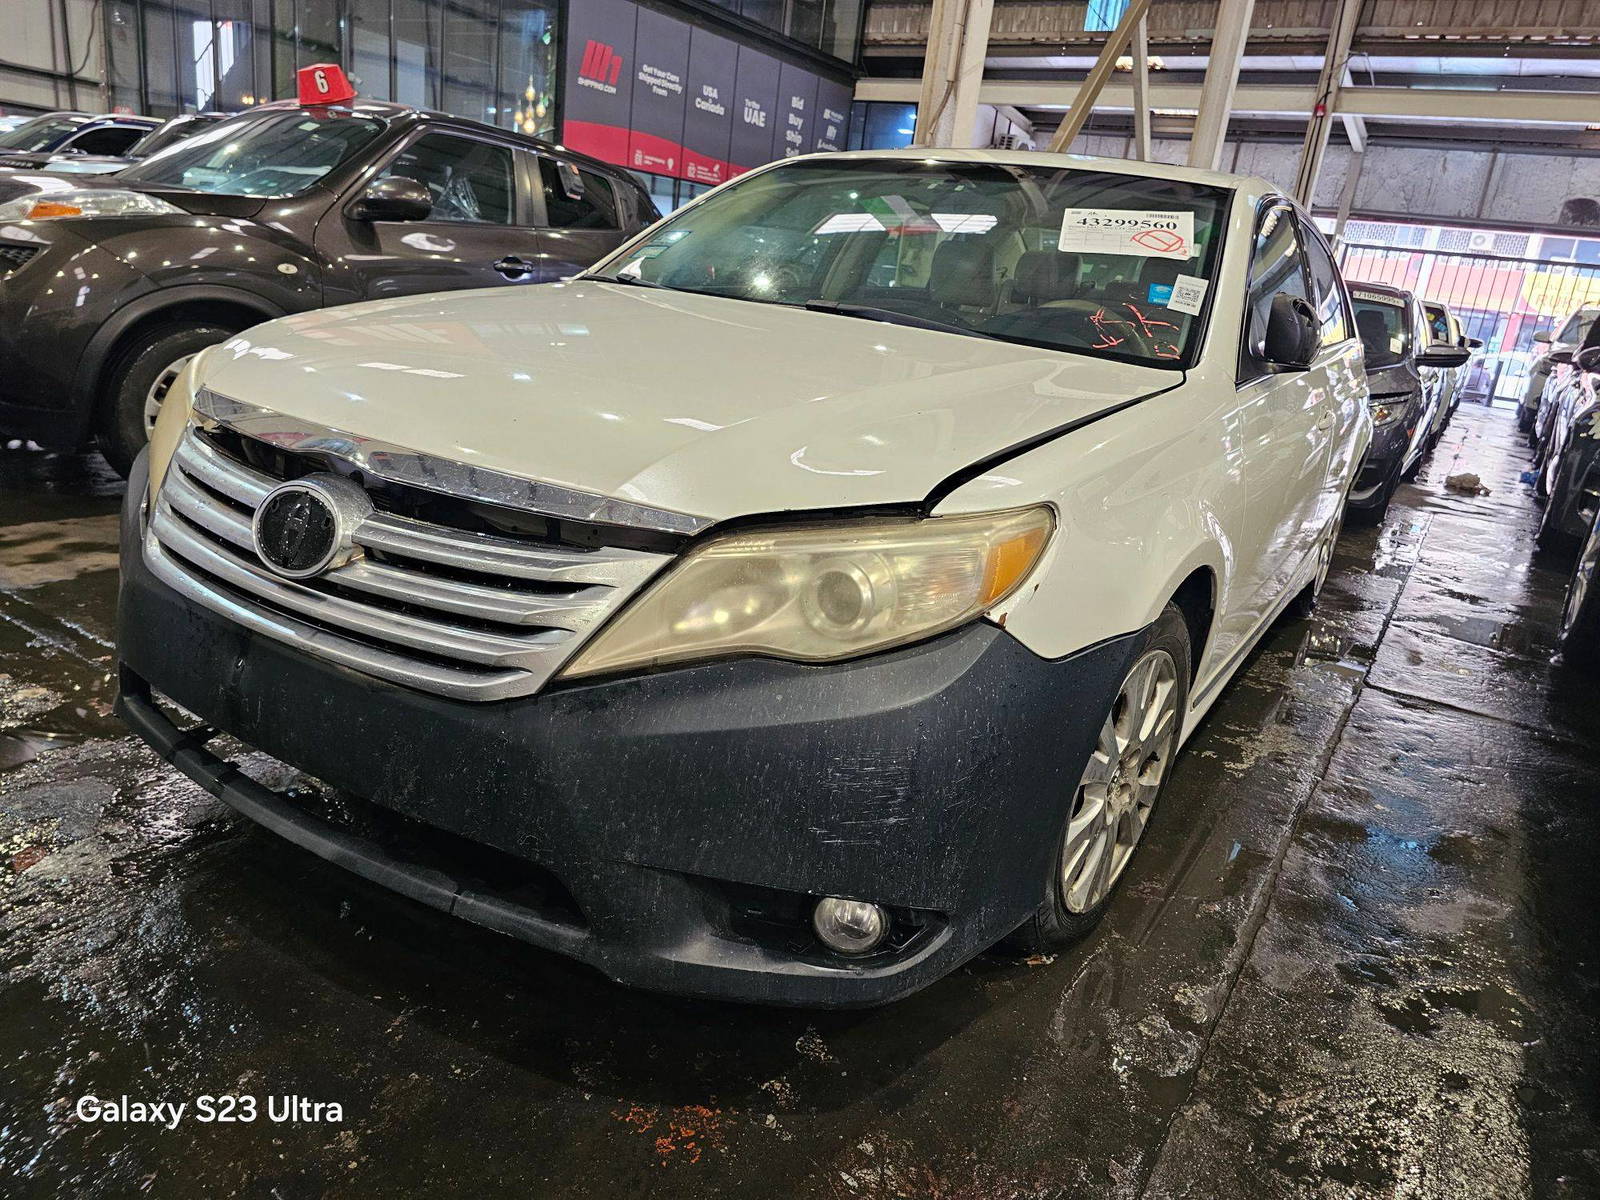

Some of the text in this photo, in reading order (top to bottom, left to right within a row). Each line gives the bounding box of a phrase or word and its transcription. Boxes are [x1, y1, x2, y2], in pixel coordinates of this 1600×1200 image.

[643, 64, 680, 82] Get Your Cars
[314, 70, 329, 94] 6
[638, 72, 682, 94] Shipped Directly
[652, 86, 668, 96] From
[702, 85, 718, 100] USA
[696, 98, 724, 116] Canada
[792, 96, 804, 110] Bid
[744, 107, 766, 128] UAE
[788, 114, 804, 130] Buy
[786, 130, 802, 146] Ship
[1076, 217, 1178, 231] 43299560
